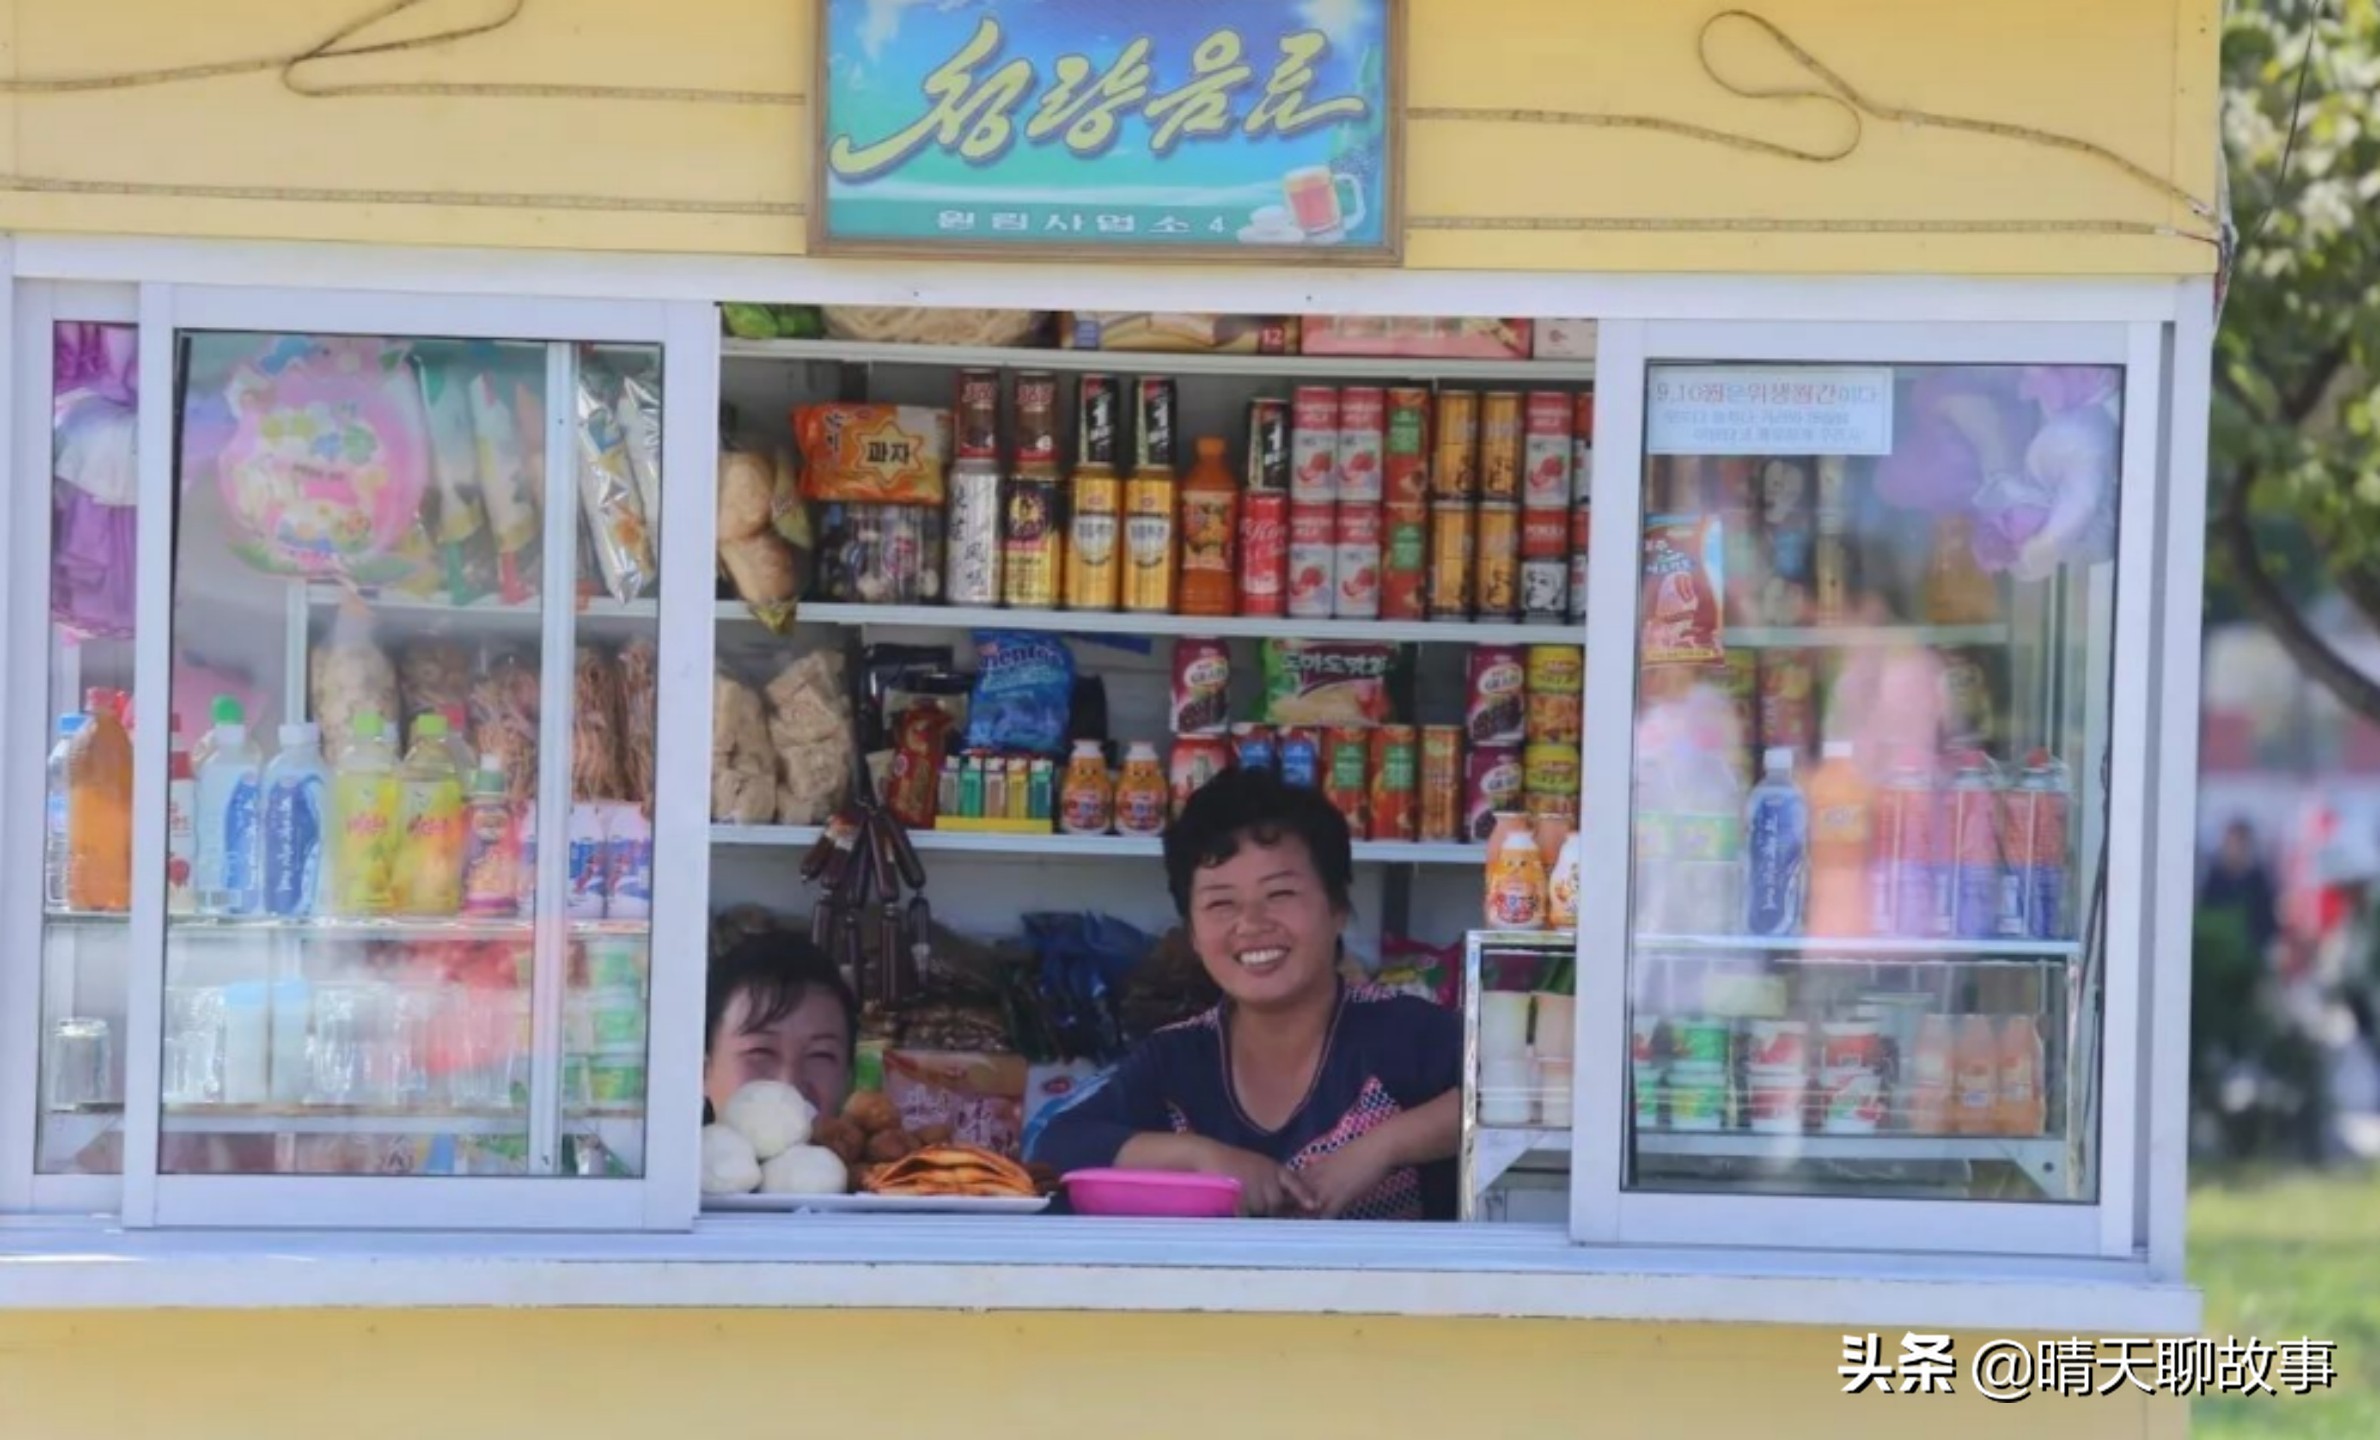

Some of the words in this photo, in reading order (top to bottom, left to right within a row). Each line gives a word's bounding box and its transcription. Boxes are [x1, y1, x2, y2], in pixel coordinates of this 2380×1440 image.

[829, 17, 1368, 177] 청량음료
[938, 210, 1191, 233] 원림사업소
[1209, 215, 1225, 233] 4
[868, 441, 910, 464] 과자
